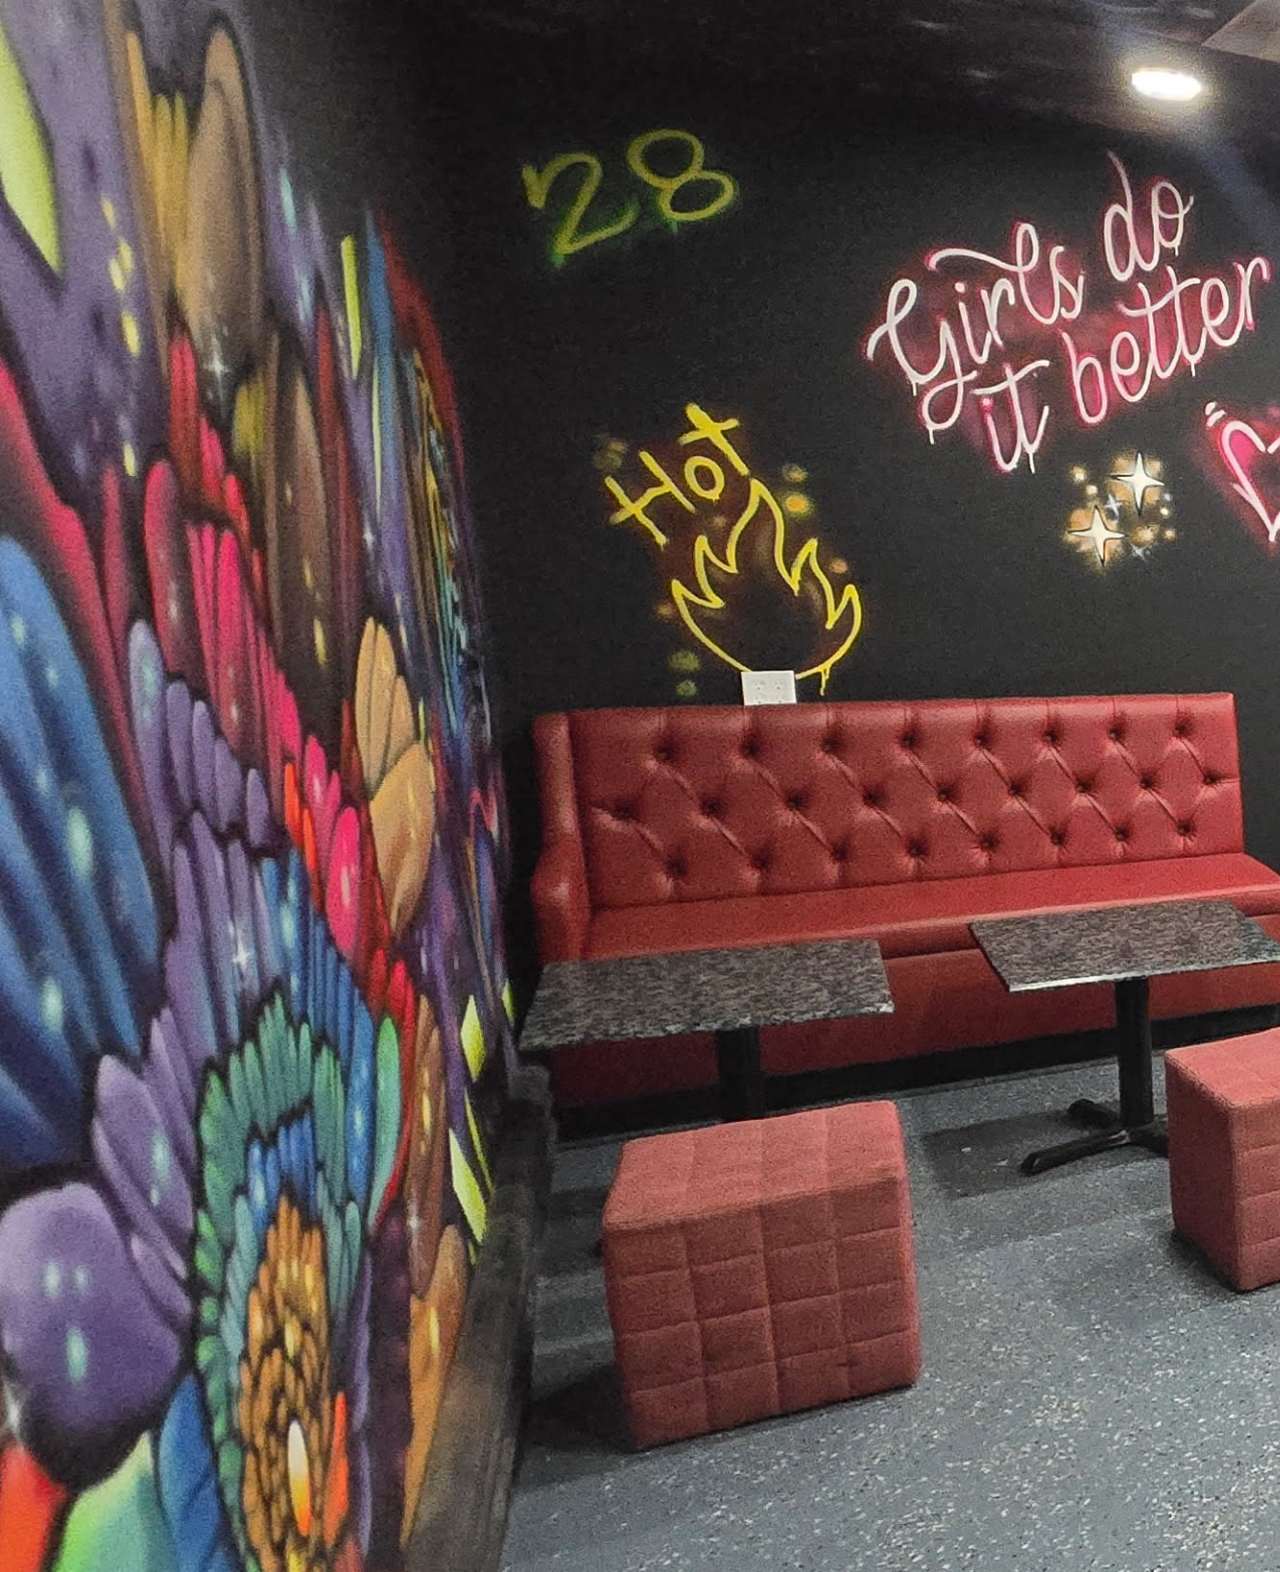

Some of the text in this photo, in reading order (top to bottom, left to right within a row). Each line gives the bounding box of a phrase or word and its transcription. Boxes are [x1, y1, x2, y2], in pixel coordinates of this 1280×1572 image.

[521, 128, 738, 257] 28
[866, 150, 1194, 431] Girls do
[972, 256, 1270, 472] it better
